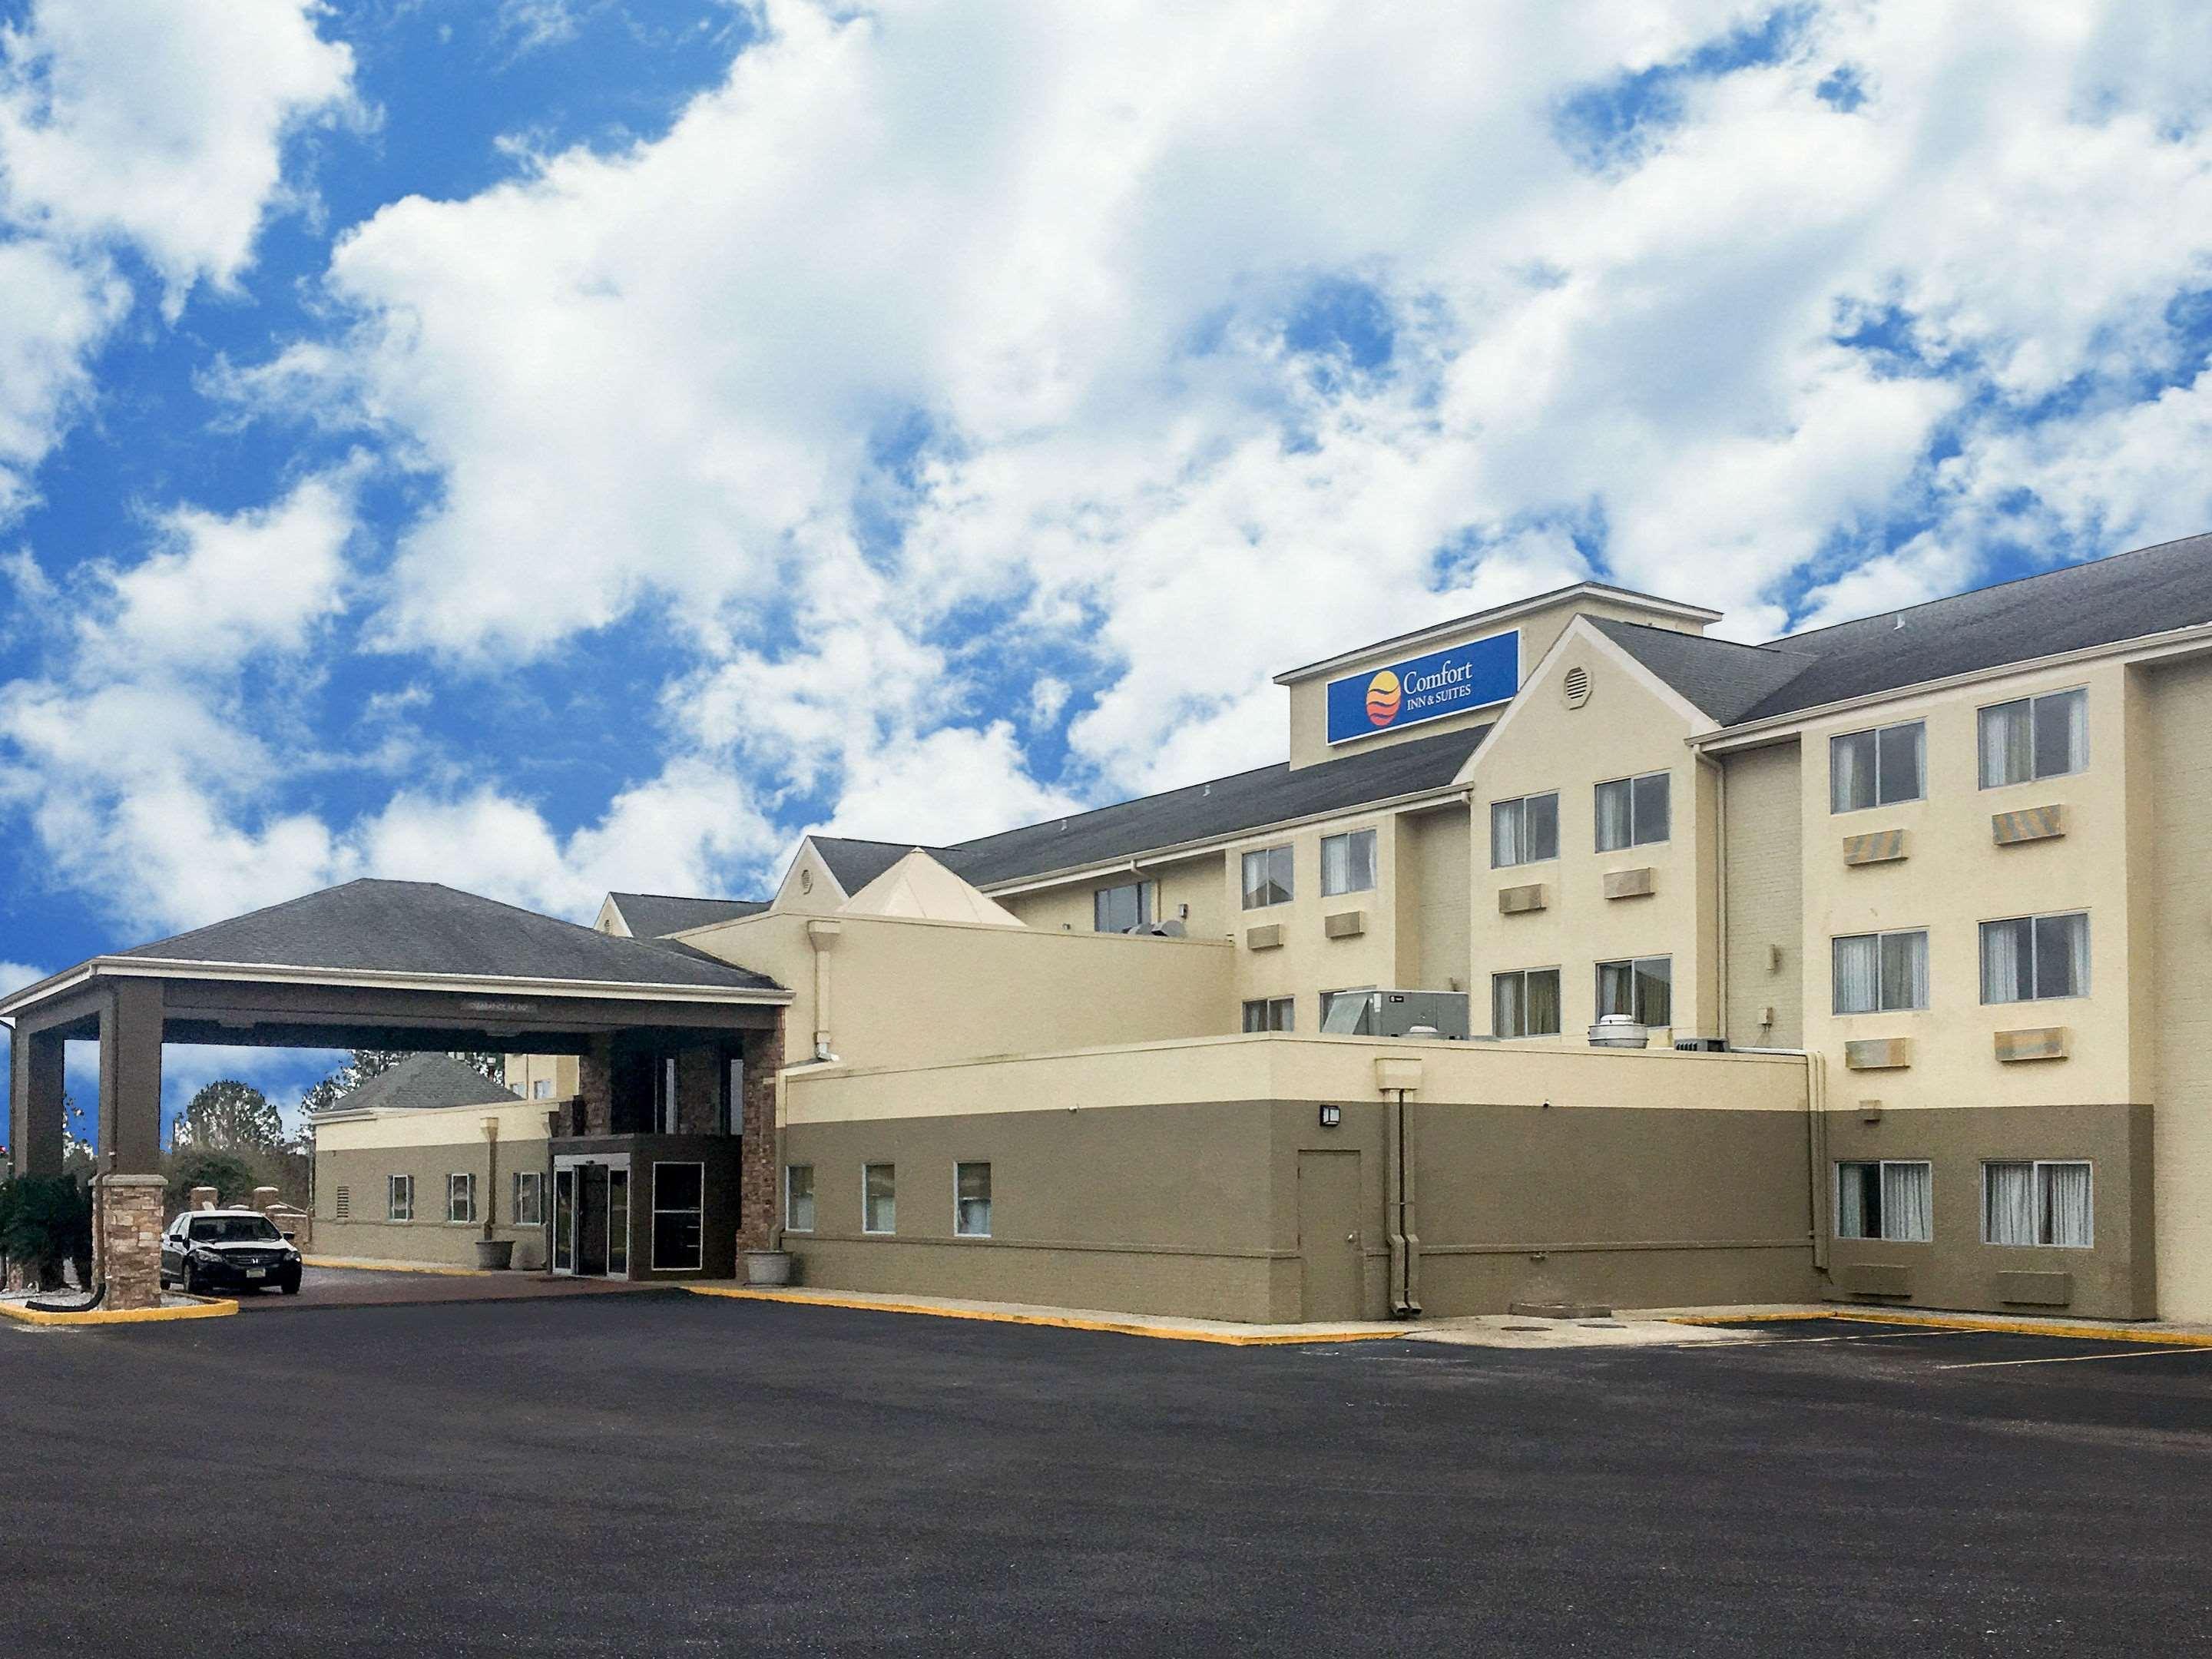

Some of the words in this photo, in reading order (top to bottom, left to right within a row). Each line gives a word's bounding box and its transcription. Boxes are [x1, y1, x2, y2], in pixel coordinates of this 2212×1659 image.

[1403, 660, 1473, 695] Comfort
[1406, 695, 1426, 711] INN
[1427, 695, 1435, 706] &
[1435, 684, 1472, 704] SUITES
